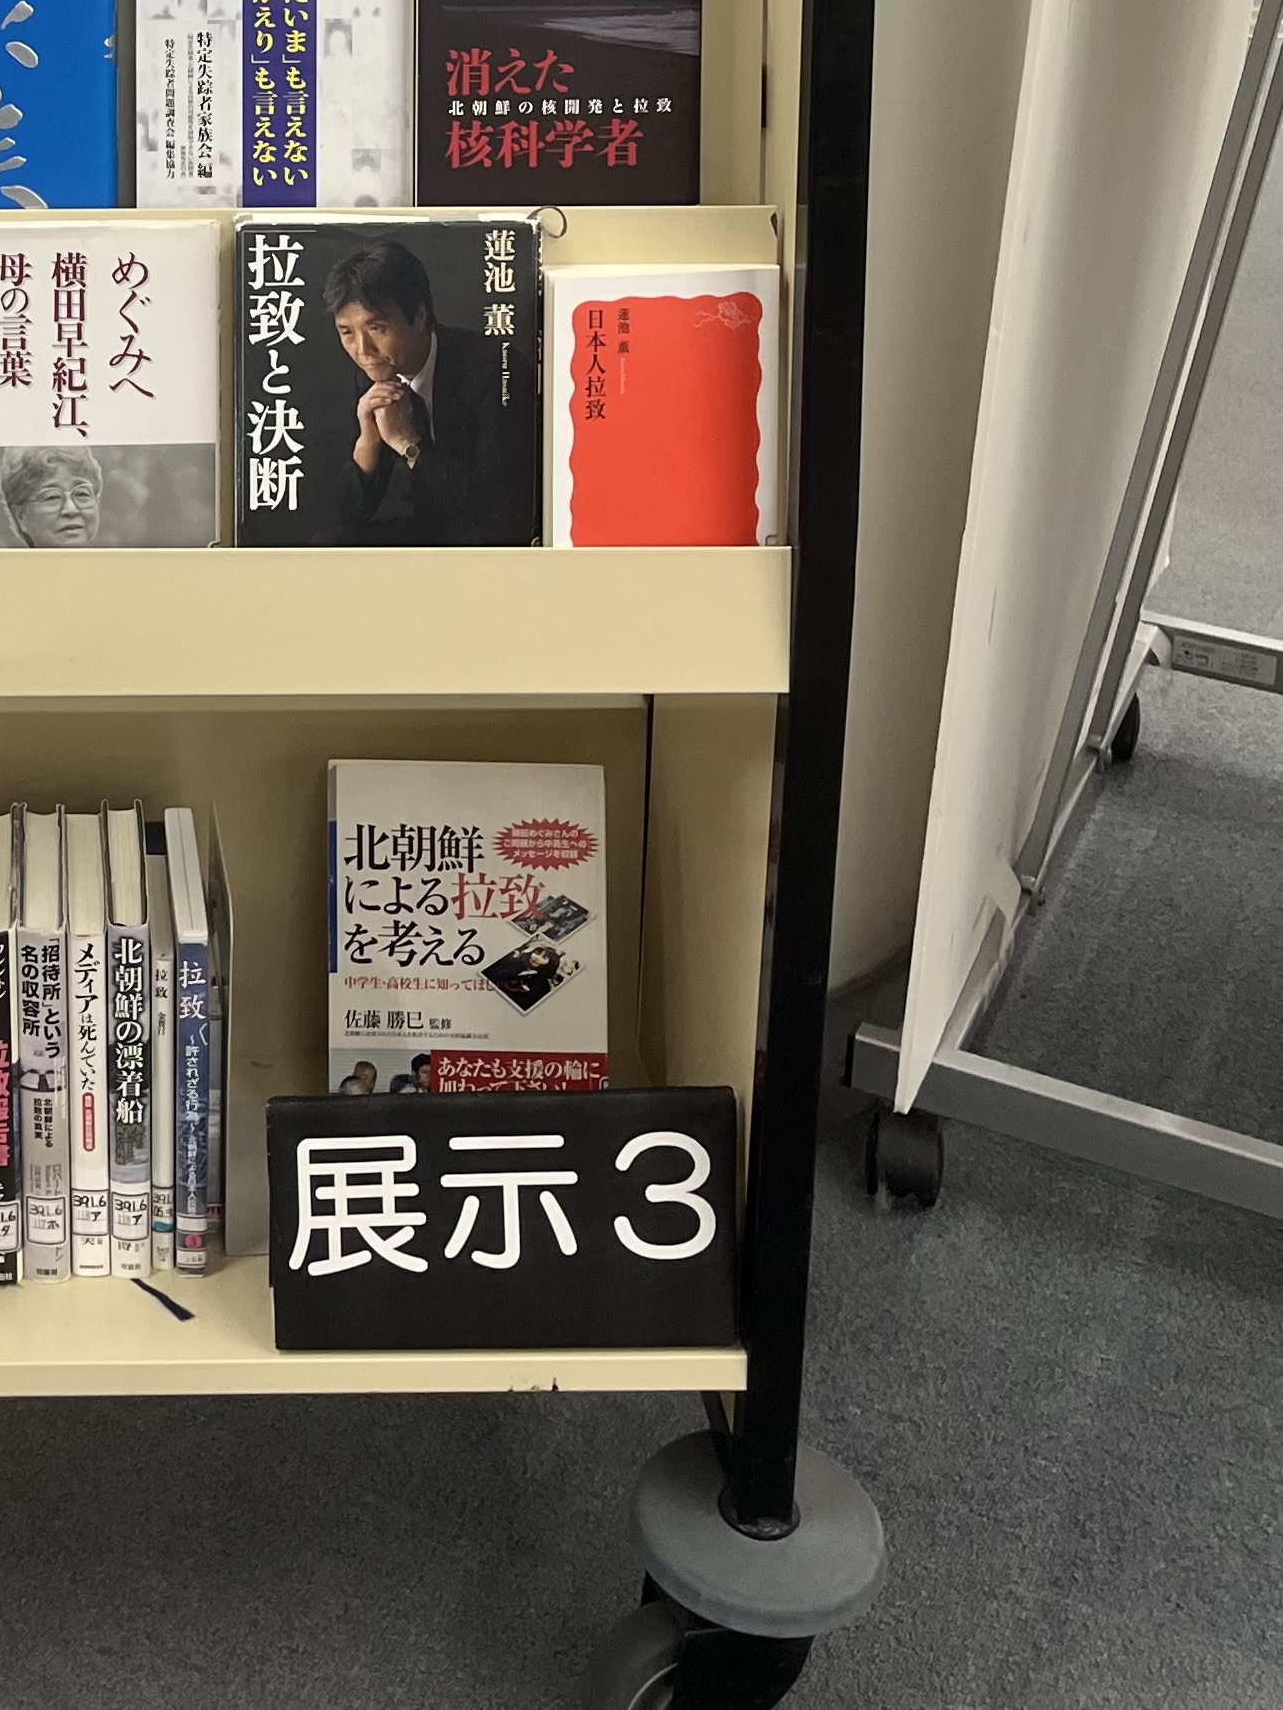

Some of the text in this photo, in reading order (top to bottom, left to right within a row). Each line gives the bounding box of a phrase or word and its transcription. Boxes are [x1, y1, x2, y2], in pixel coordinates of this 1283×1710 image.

[197, 31, 213, 159] 特定失踪者家族会
[445, 47, 575, 97] 消えた
[448, 97, 672, 116] 北朝鮮の核開発と拉致
[445, 118, 644, 169] 核科学者
[109, 252, 156, 400] めぐみへ
[483, 229, 516, 336] 蓮池 薫
[51, 251, 90, 438] 横田早紀江、
[247, 234, 305, 511] 拉致と決断
[585, 310, 606, 420] 日本人拉致
[344, 823, 485, 873] 北朝鮮
[345, 872, 546, 920] による拉致
[155, 968, 168, 999] 拉致
[344, 920, 485, 967] を考える
[21, 946, 40, 1036] 名の収容所
[42, 938, 61, 1058] 「招待所」という
[75, 943, 100, 1090] メディアは死んでいた
[115, 938, 144, 1124] 北朝鮮の漂着船
[179, 961, 207, 1019] 拉致
[345, 1009, 381, 1030] 佐藤
[429, 1018, 452, 1030] 監修
[437, 1057, 600, 1079] あなたも支援の輪に
[288, 1131, 717, 1276] 展示3
